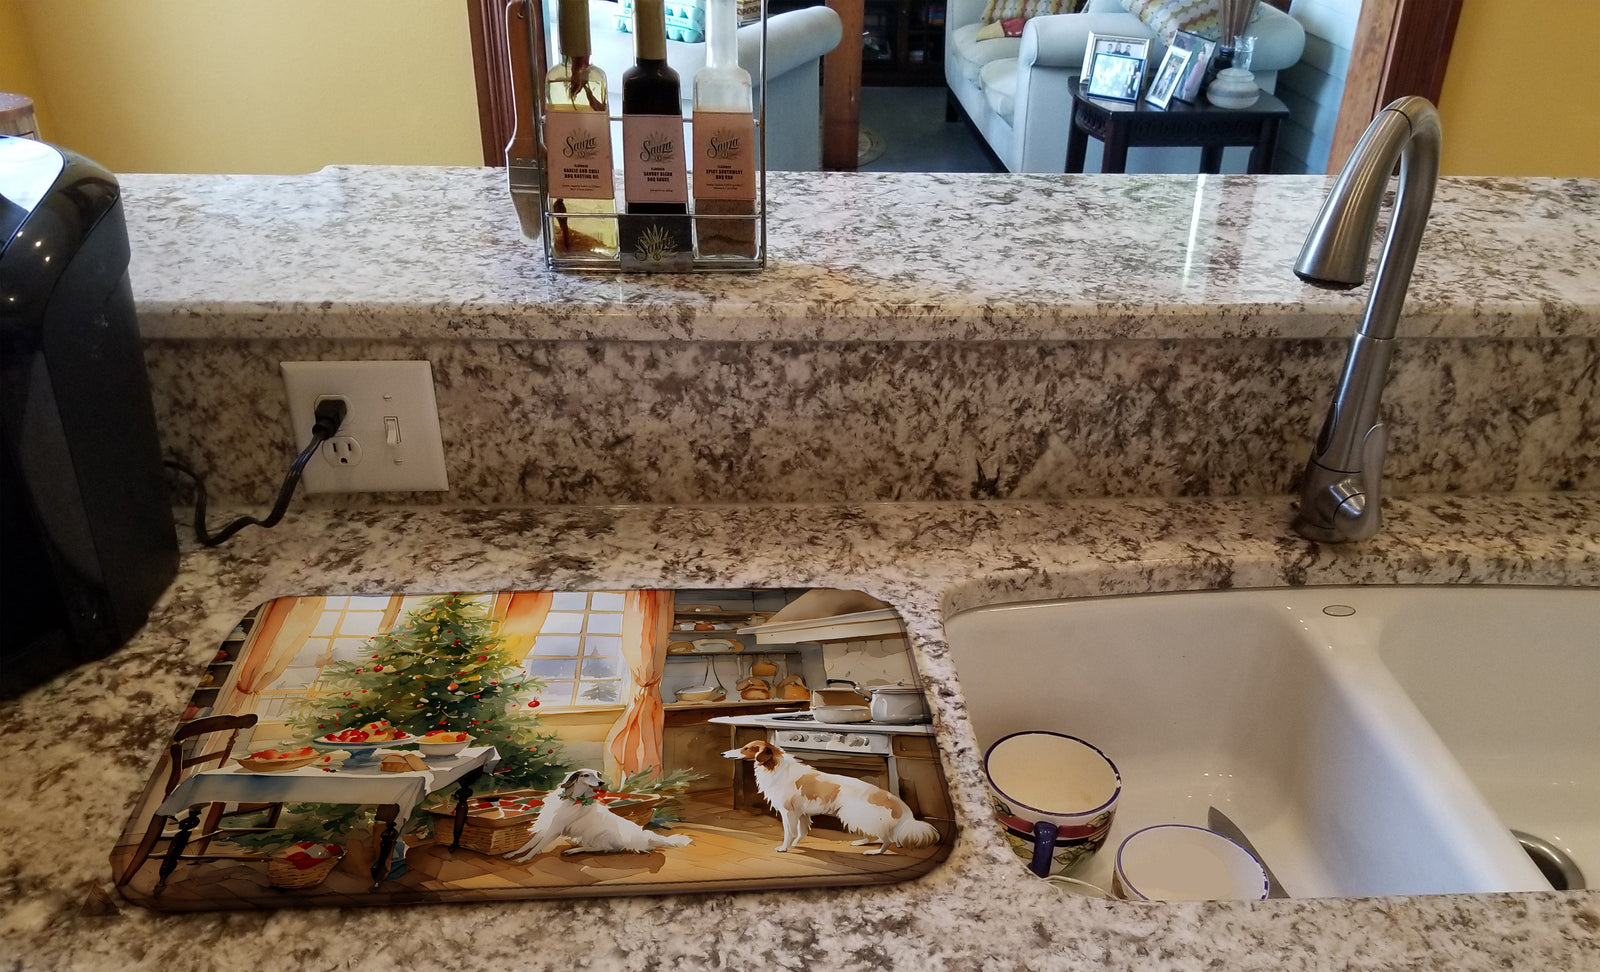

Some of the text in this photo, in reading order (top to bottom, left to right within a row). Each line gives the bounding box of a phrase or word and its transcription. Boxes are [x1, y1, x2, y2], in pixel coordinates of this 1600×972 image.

[563, 136, 597, 158] Sauza
[640, 140, 673, 161] Sauza
[706, 137, 739, 158] Sauza
